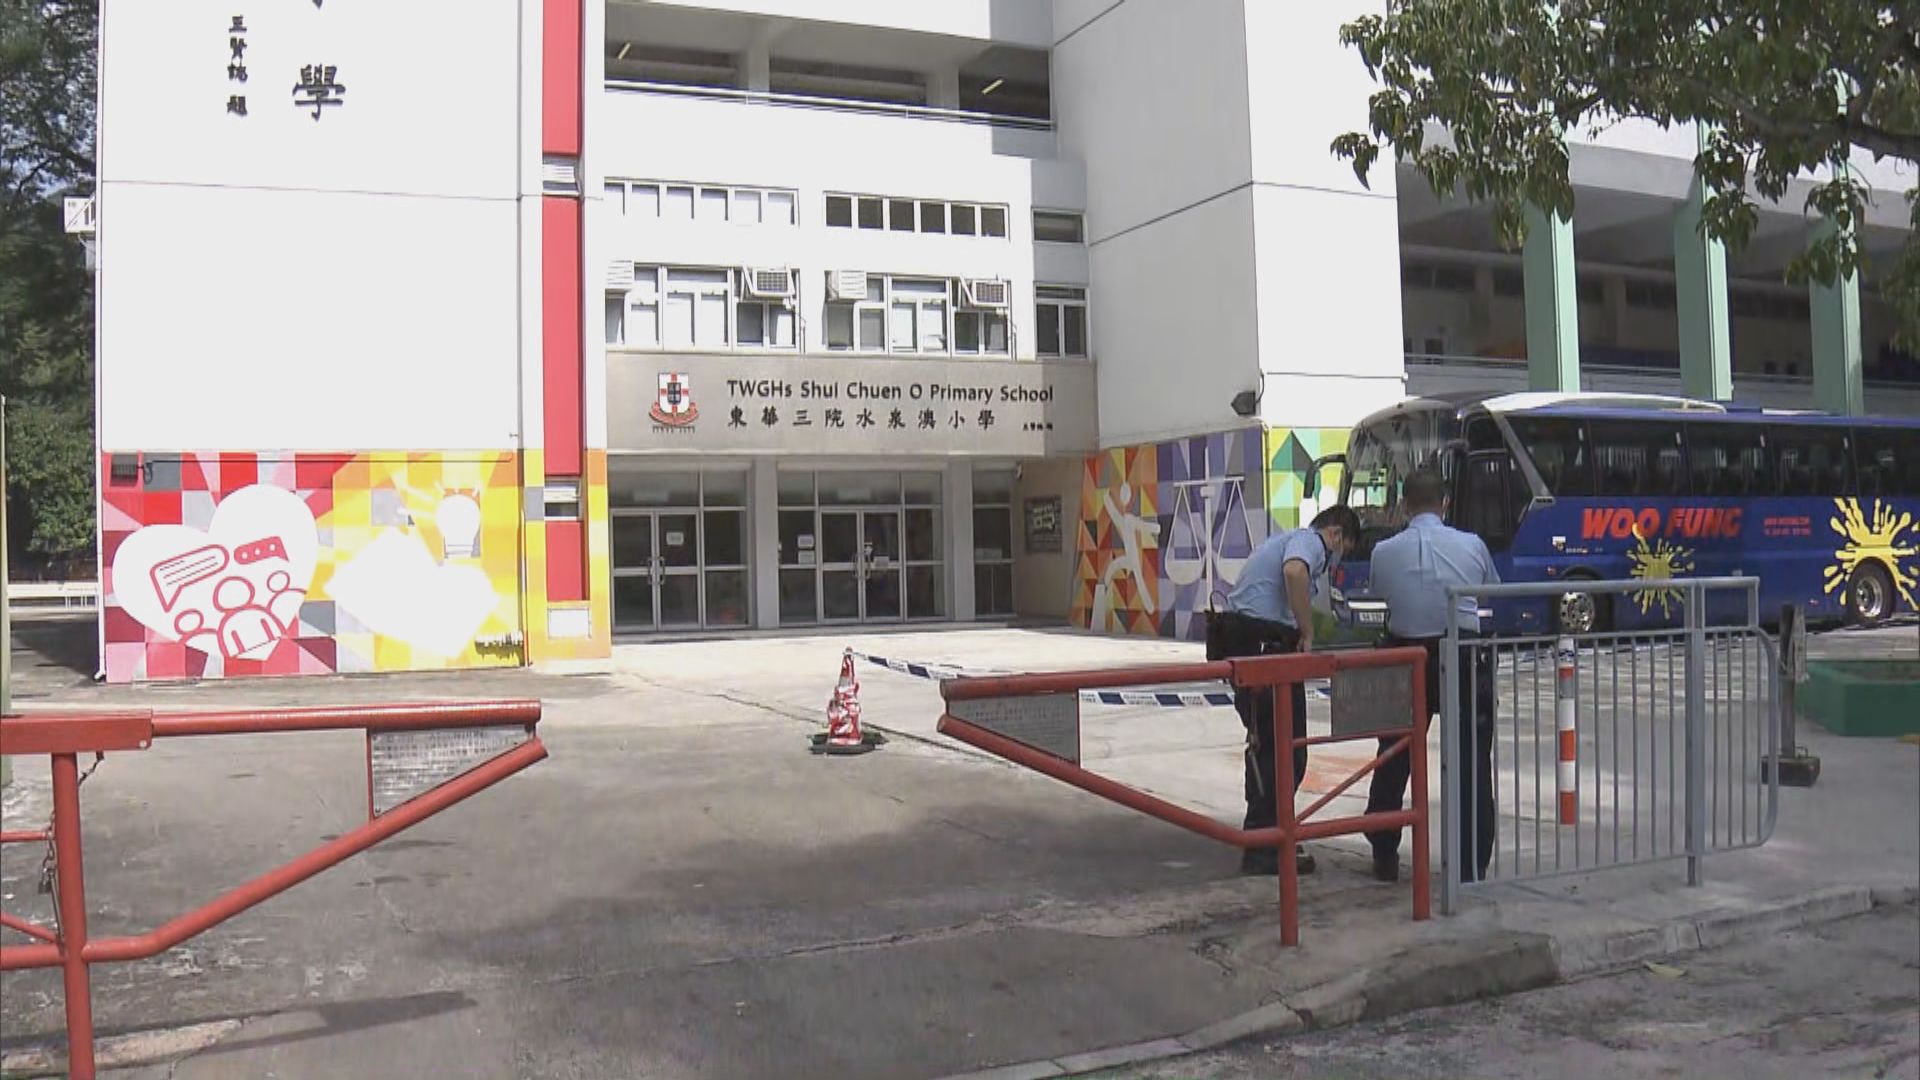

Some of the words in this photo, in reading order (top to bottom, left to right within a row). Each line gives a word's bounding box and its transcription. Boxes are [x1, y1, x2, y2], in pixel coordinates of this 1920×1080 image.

[727, 379, 792, 399] TWGHs
[801, 380, 838, 400] Shui
[847, 381, 901, 400] Chuen
[909, 383, 923, 400] O
[930, 383, 993, 405] Primary
[1000, 384, 1053, 401] School
[727, 404, 995, 430] 東華三院水泉澳小學
[1582, 507, 1661, 539] WOO
